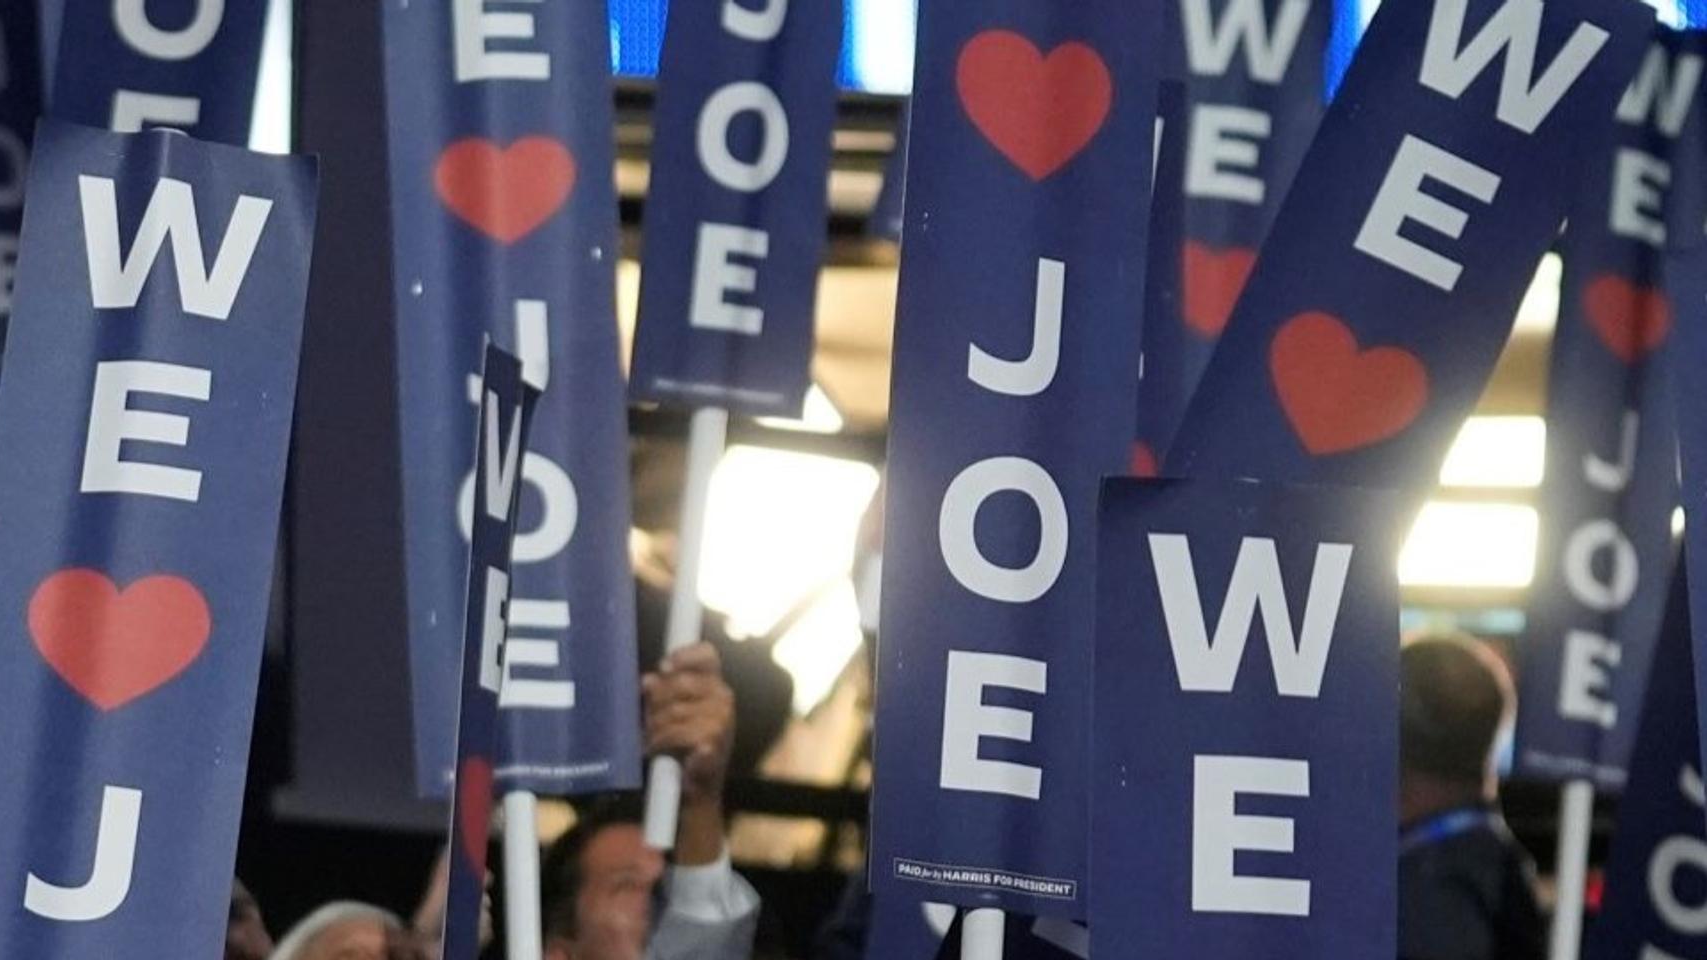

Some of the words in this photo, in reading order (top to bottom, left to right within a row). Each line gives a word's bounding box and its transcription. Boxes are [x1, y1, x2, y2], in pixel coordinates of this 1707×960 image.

[454, 0, 552, 83] E
[1181, 0, 1311, 204] WE
[1354, 0, 1610, 291] WE
[78, 174, 274, 501] WE
[939, 257, 1069, 800] JOE
[1557, 408, 1639, 729] JOE
[1147, 532, 1354, 917] WE
[898, 863, 921, 877] PAID
[942, 870, 992, 885] HARRIS
[993, 874, 1013, 887] FOR
[1013, 878, 1072, 896] PRESIDENT
